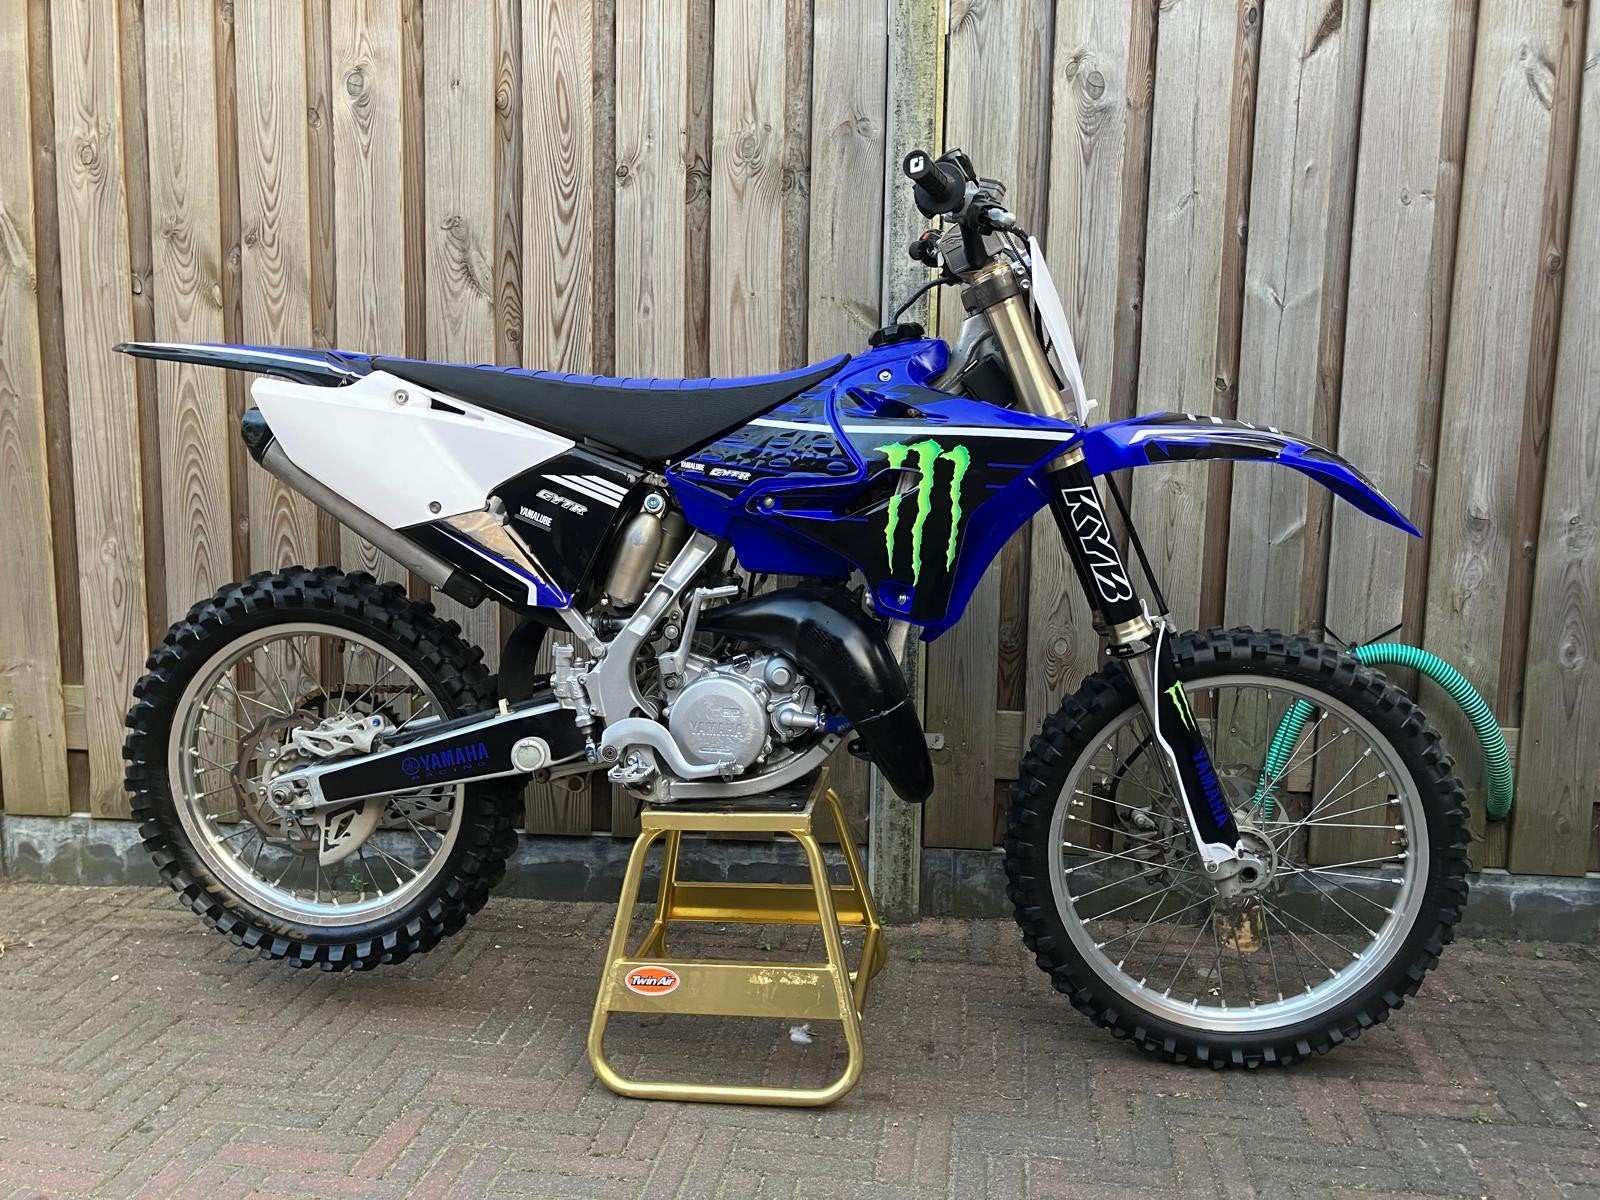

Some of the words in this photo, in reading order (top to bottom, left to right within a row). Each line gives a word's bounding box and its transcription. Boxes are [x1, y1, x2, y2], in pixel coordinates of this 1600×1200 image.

[519, 505, 553, 527] YAMALUBE
[536, 488, 588, 516] GYTR
[1061, 486, 1133, 603] KYB
[419, 742, 489, 771] YAMAHA
[1192, 746, 1229, 829] YAMAHA
[631, 975, 657, 986] Twin
[656, 976, 676, 986] Air
